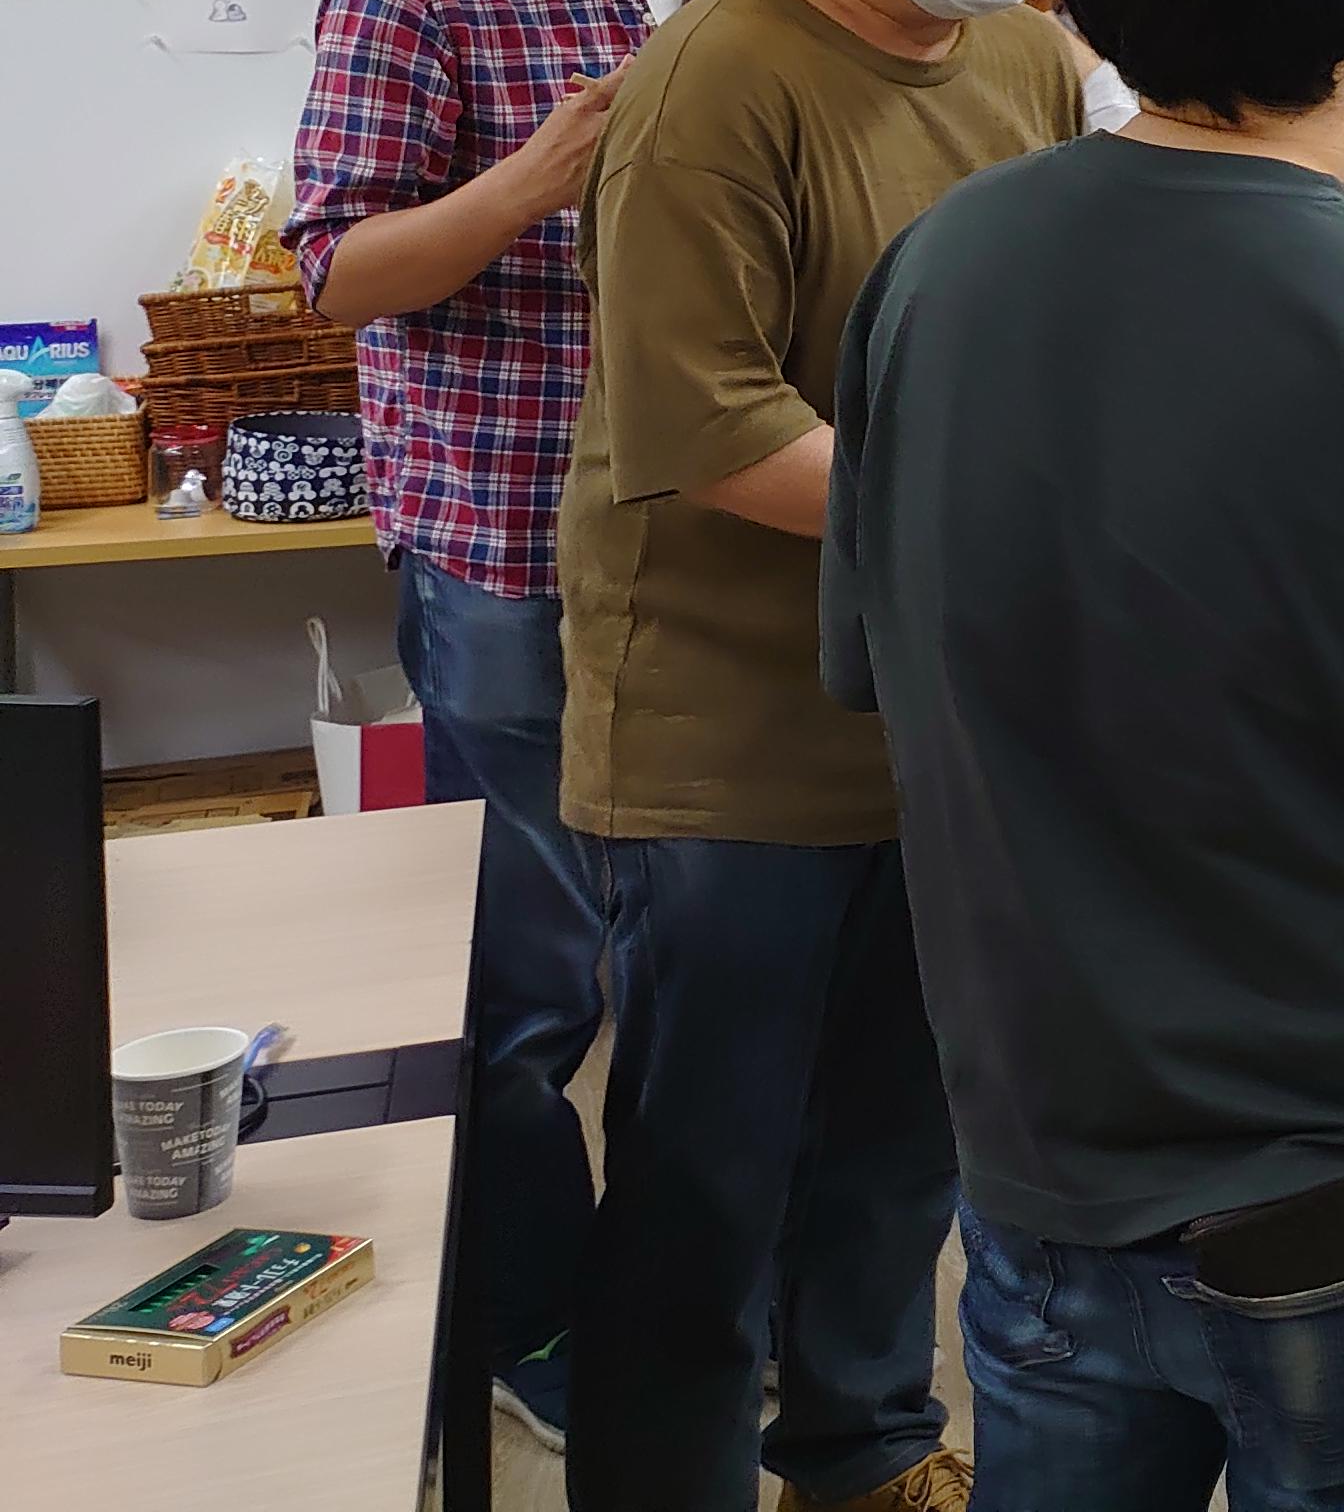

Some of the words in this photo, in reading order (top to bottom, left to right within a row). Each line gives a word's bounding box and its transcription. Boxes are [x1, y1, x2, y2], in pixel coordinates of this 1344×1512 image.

[0, 335, 91, 366] QUARIUS
[140, 1101, 184, 1112] TODAY
[161, 1130, 200, 1151] MAKE
[146, 1176, 187, 1186] TODAY
[110, 1352, 152, 1371] meiji
